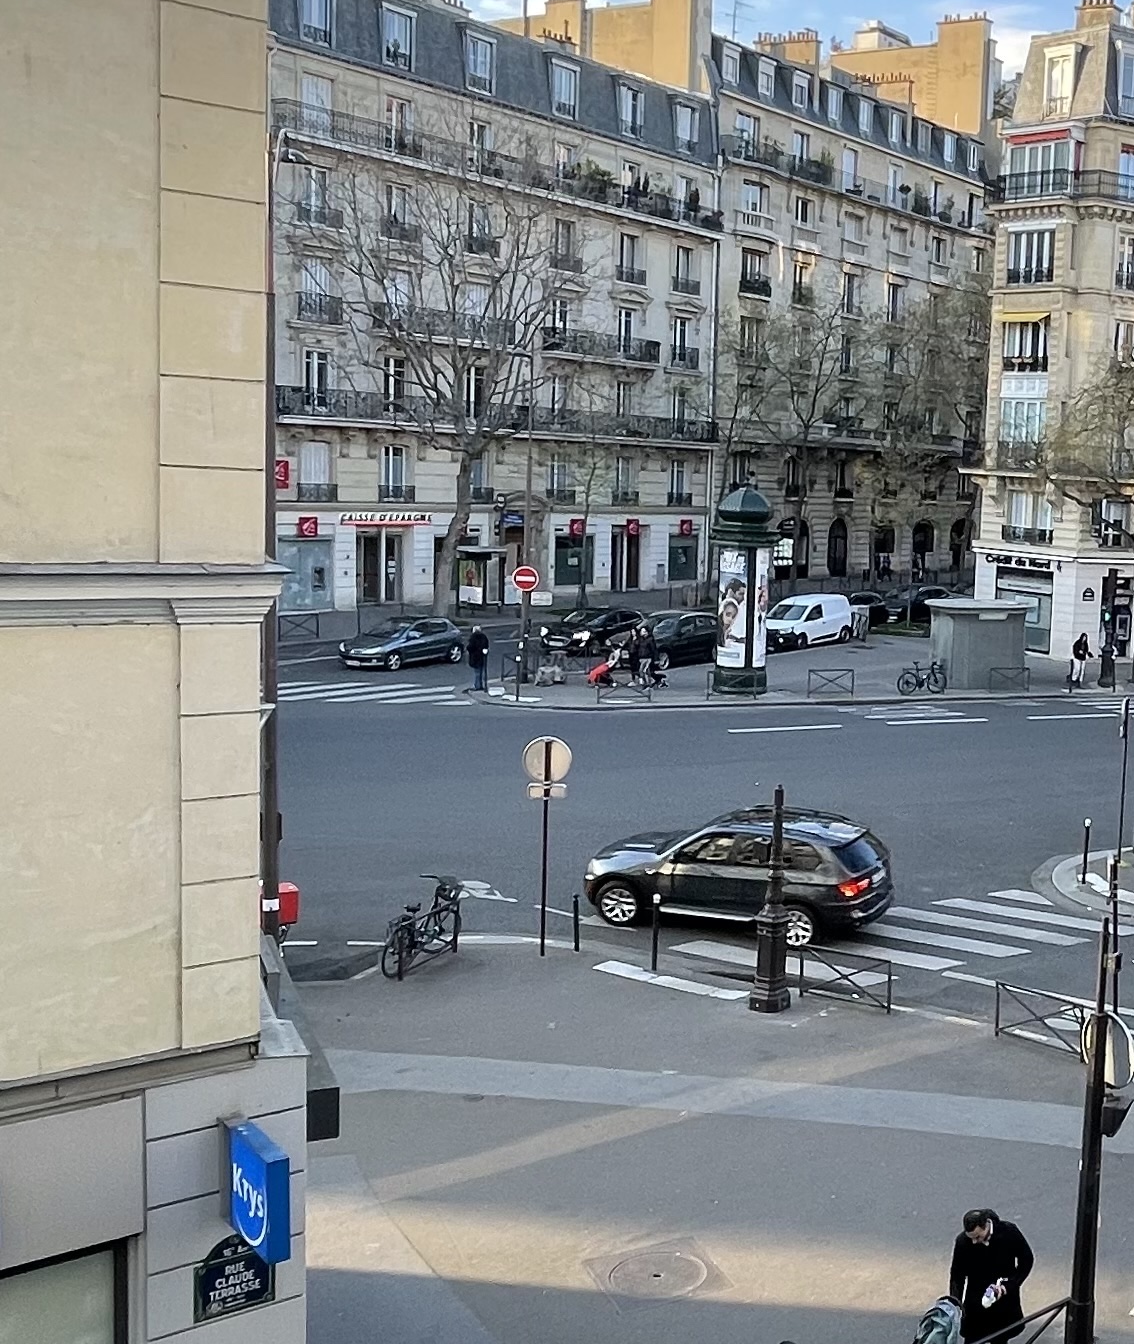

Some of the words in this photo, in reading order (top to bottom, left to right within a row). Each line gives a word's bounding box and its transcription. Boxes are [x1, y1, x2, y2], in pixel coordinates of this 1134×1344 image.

[340, 512, 375, 522] CAISSE
[232, 1163, 264, 1218] Krys
[225, 1261, 245, 1276] RUE
[215, 1269, 255, 1289] CLAUDE
[209, 1279, 261, 1302] TERRASSE
